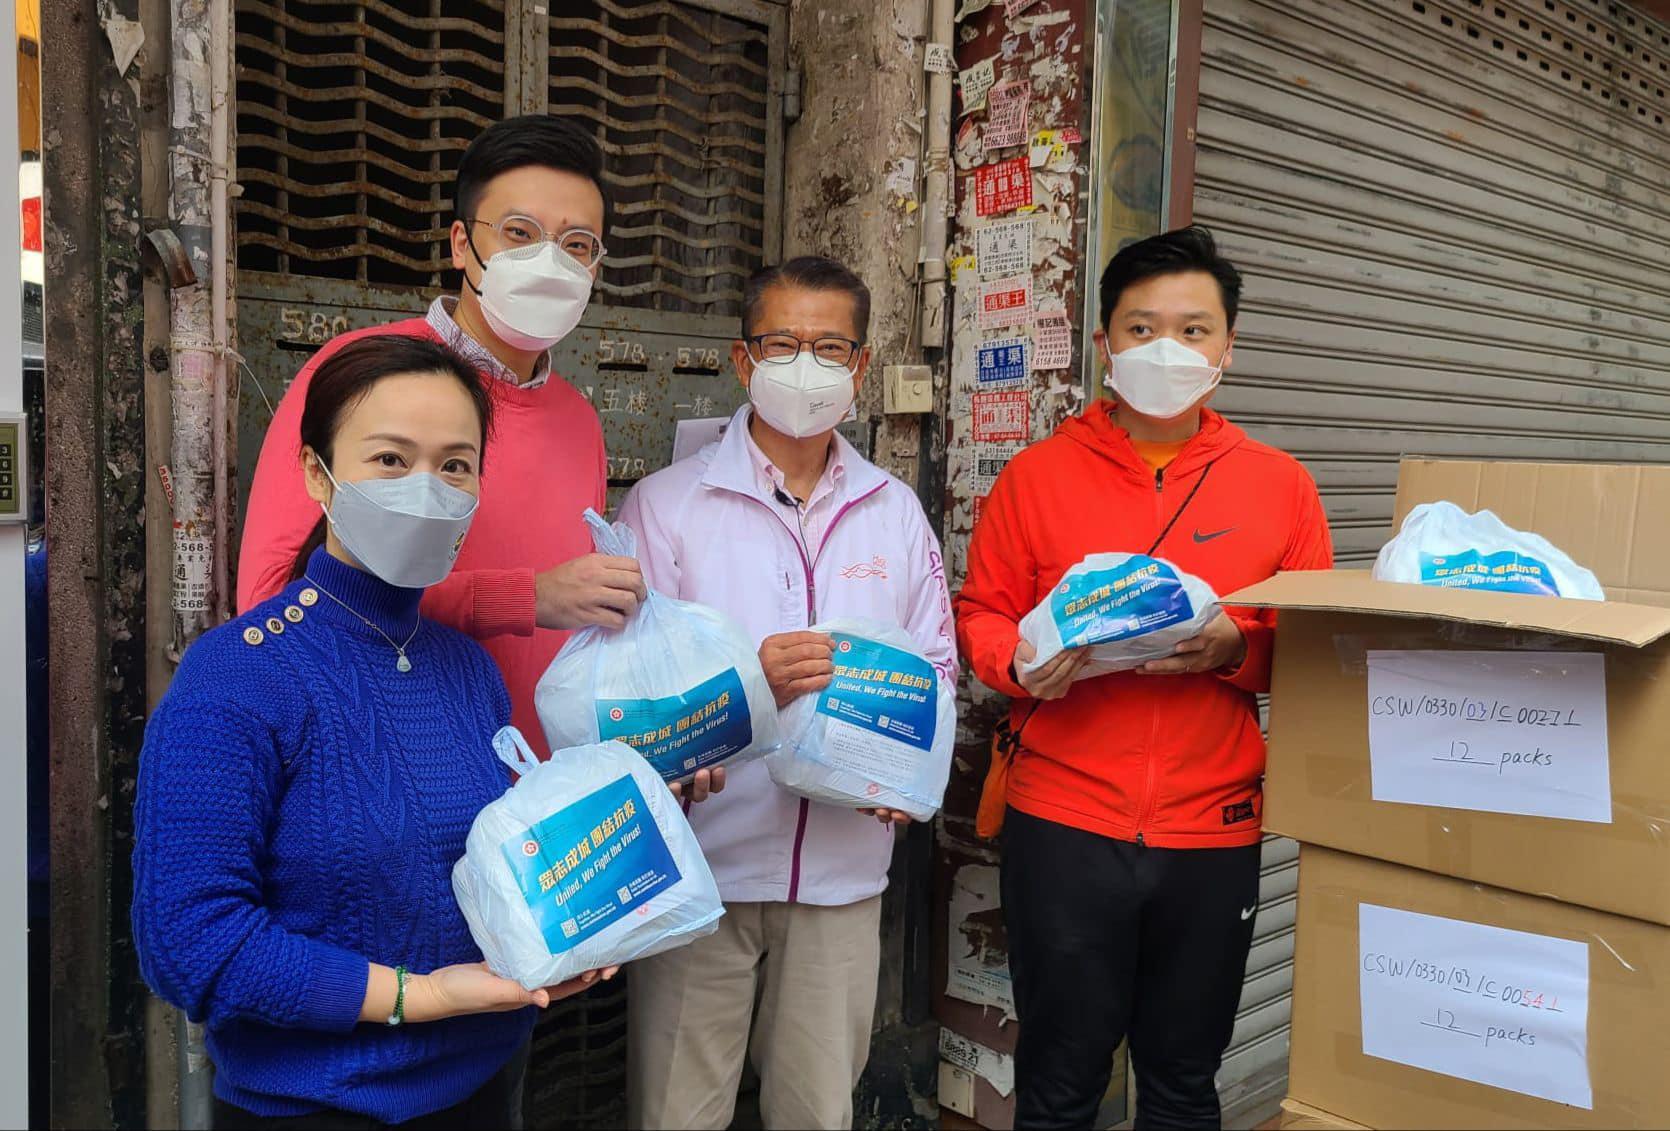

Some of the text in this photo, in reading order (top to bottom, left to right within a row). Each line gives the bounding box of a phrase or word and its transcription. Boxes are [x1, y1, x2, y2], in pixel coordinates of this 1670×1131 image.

[600, 340, 646, 364] 578
[676, 347, 720, 369] 578
[654, 745, 667, 755] We
[669, 734, 691, 751] Fight
[691, 727, 705, 738] the
[705, 712, 729, 730] Virus!
[1450, 741, 1552, 775] 12 packs
[555, 823, 641, 906] United, We Fight the Virus!
[1437, 1008, 1536, 1047] 12 packs
